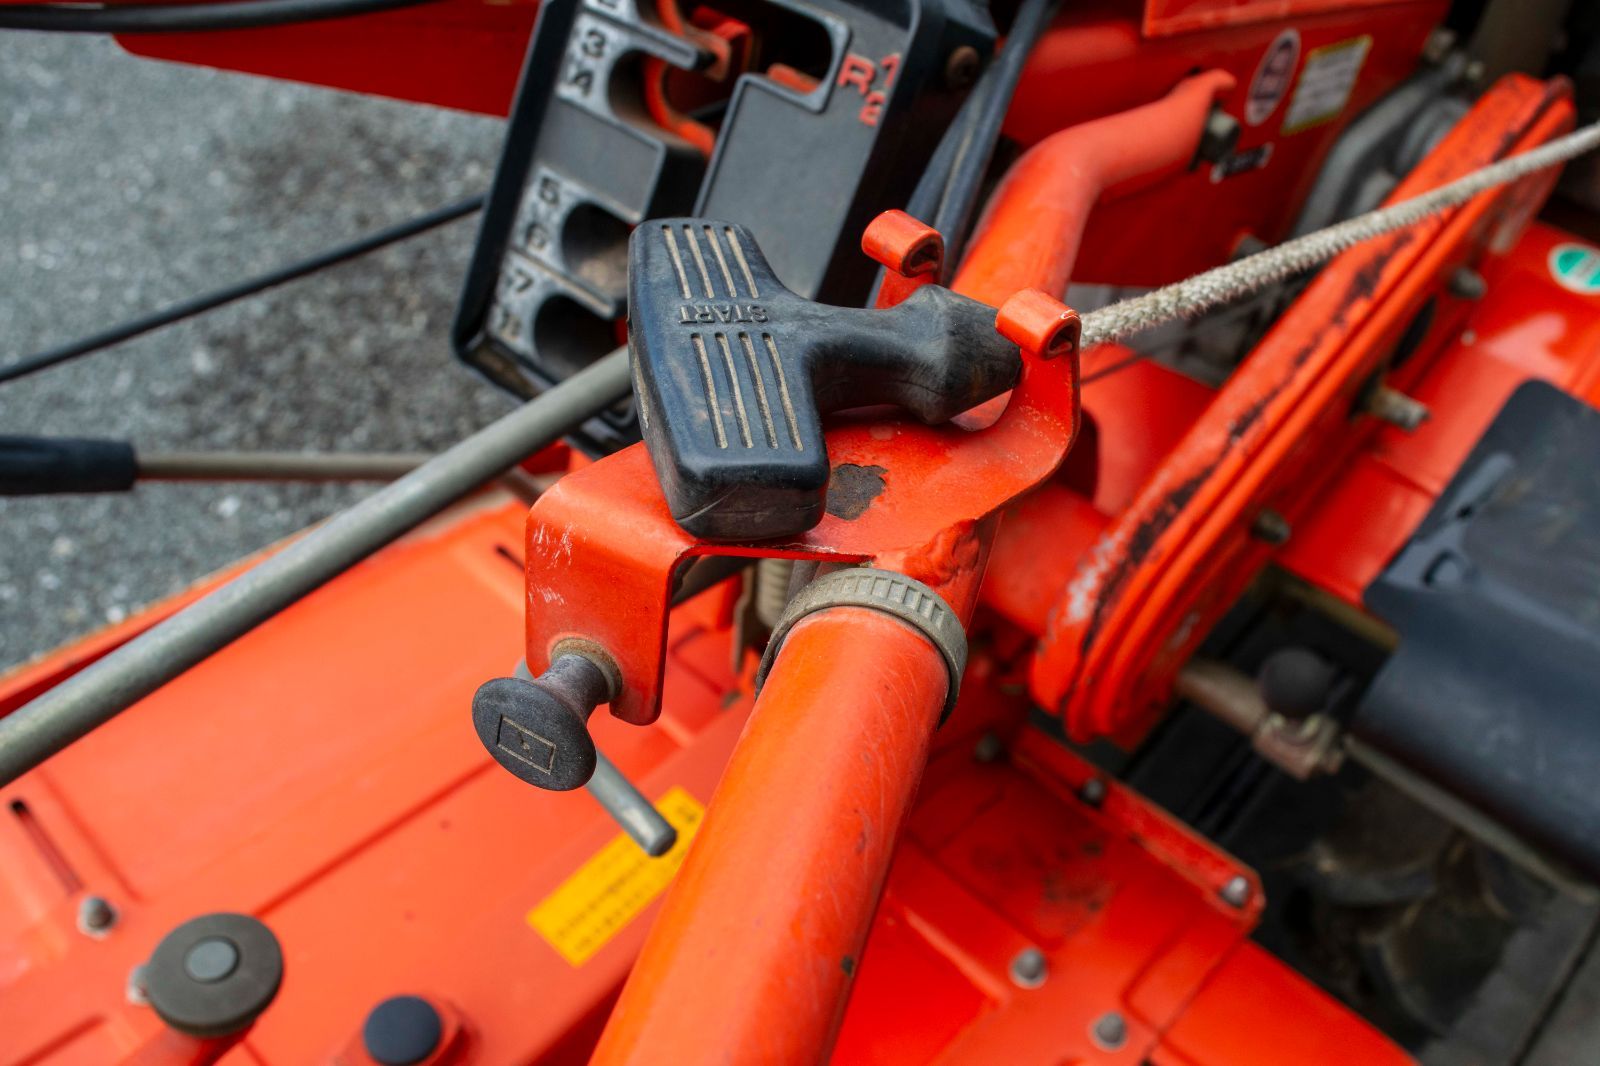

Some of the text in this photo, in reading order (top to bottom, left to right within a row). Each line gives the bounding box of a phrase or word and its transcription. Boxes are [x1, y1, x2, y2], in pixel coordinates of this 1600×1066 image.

[581, 27, 607, 60] 3
[568, 70, 595, 98] 4
[859, 91, 886, 127] 2
[539, 176, 561, 206] 5
[526, 221, 549, 250] 6
[512, 267, 534, 293] 7
[679, 304, 769, 325] START
